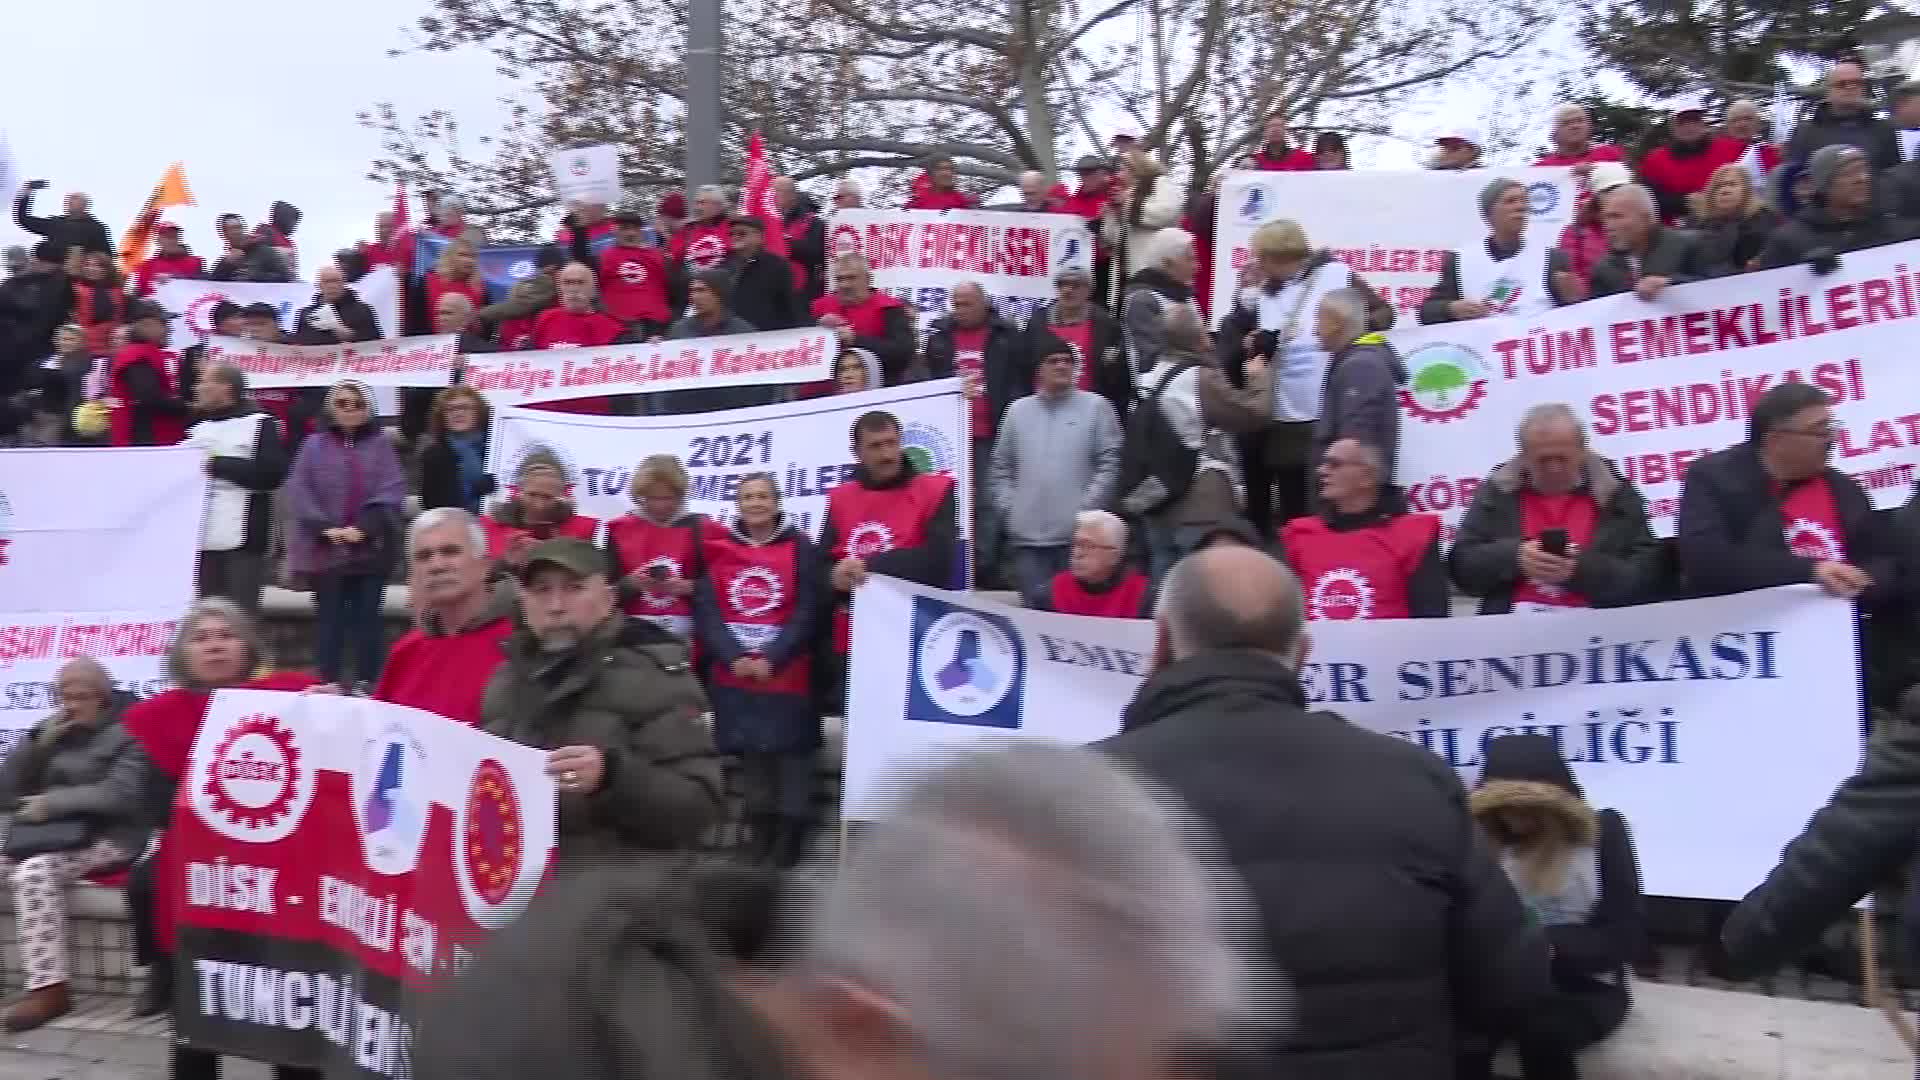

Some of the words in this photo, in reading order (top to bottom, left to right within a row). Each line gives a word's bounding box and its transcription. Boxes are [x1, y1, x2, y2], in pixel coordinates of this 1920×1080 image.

[465, 361, 553, 396] Türkiye
[711, 336, 825, 377] Kalacak!
[1493, 326, 1595, 381] TÜM
[686, 431, 774, 467] 2021
[582, 465, 630, 496] TÜ
[1398, 630, 1780, 701] SENDİKASI
[223, 751, 284, 781] DİSK
[186, 856, 278, 914] DİSK
